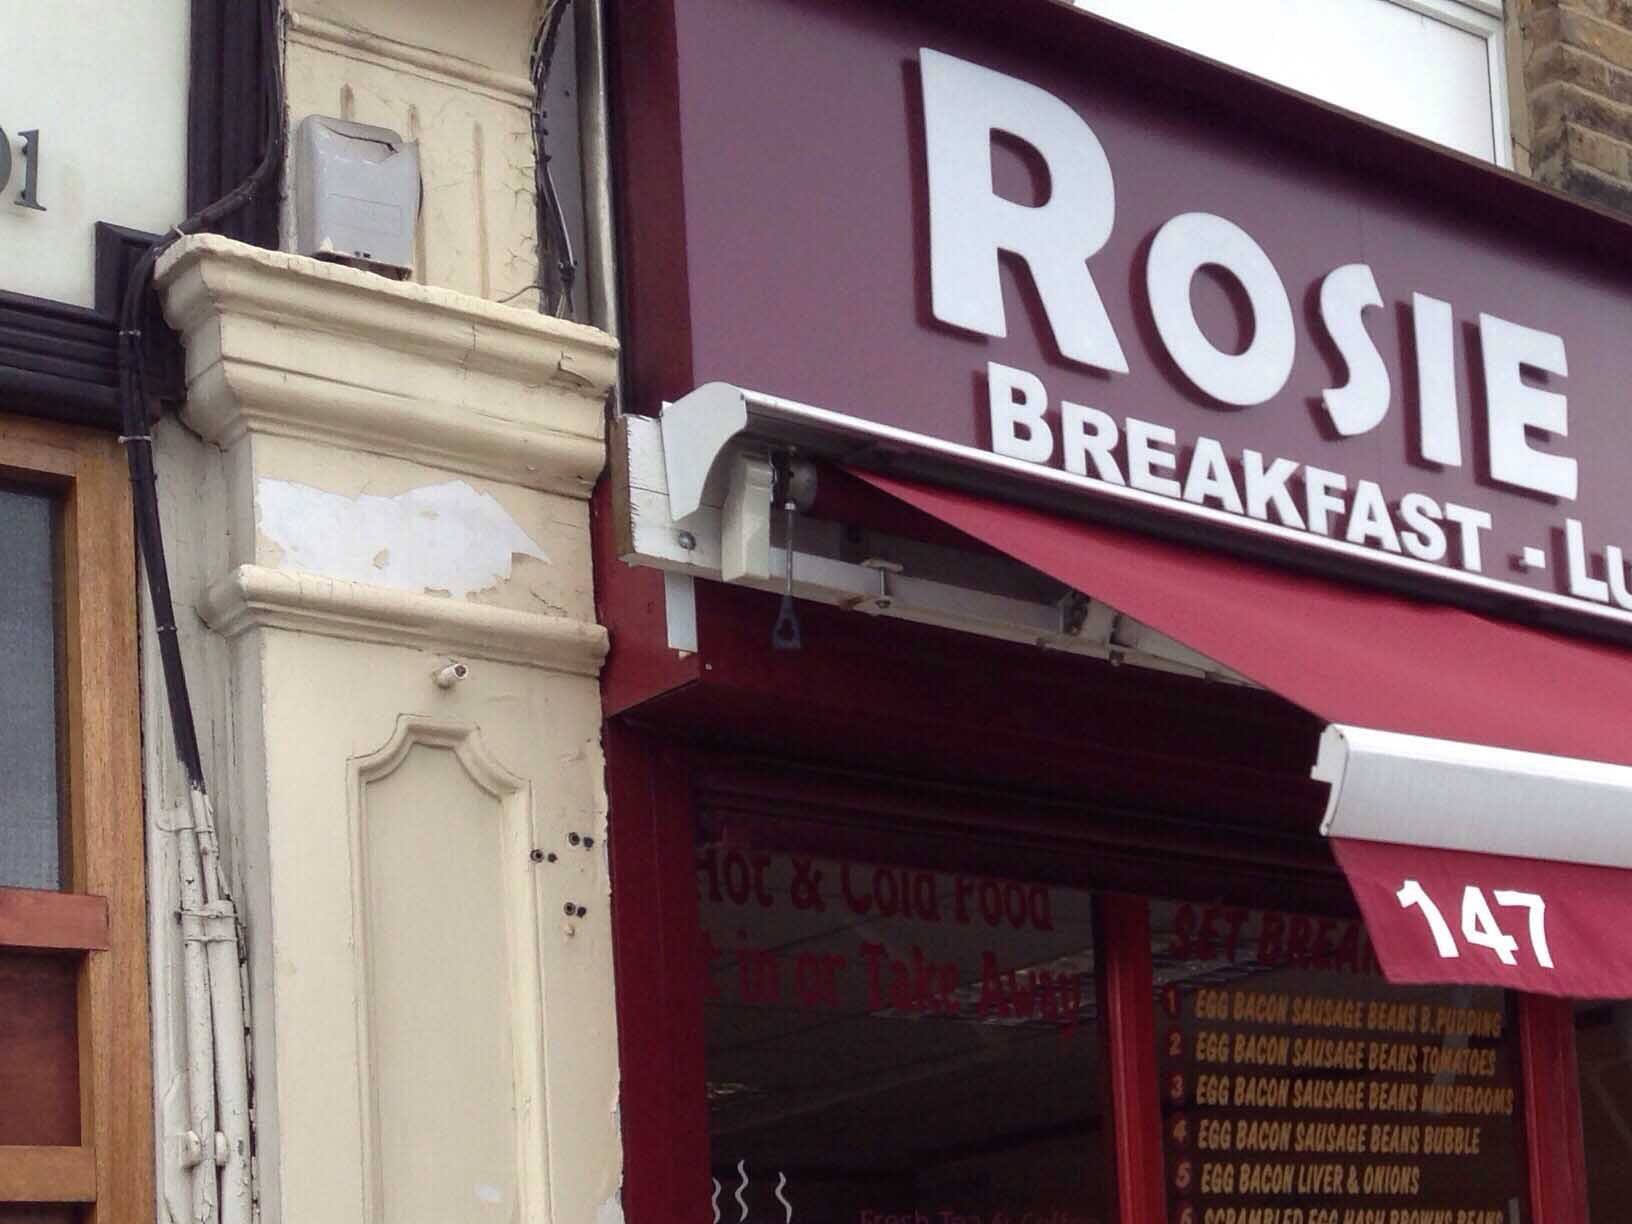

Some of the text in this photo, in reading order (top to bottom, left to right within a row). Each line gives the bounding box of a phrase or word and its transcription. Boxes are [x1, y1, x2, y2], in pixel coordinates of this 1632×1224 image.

[919, 47, 1578, 502] ROSIE
[987, 361, 1492, 572] BREAKFAST
[1396, 880, 1555, 969] 147
[1195, 990, 1228, 1021] EGG
[1233, 992, 1288, 1024] BACON
[1292, 996, 1363, 1028] SAUSAGE
[1195, 1032, 1229, 1062] EGG
[1233, 1035, 1288, 1066] BACON
[1292, 1039, 1365, 1069] SAUSAGE
[1368, 1041, 1417, 1072] BEANS
[1196, 1074, 1229, 1105] EGG
[1234, 1077, 1289, 1108] BACON
[1293, 1080, 1365, 1111] SAUSAGE
[1369, 1083, 1418, 1112] BEANS
[1198, 1120, 1231, 1150] EGG
[1236, 1120, 1292, 1151] BACON
[1294, 1122, 1367, 1153] SAUSAGE
[1370, 1124, 1420, 1154] BEANS
[1424, 1125, 1480, 1155] BUBBLE
[1201, 1163, 1234, 1194] EGG
[1239, 1164, 1295, 1194] BACON
[1298, 1165, 1344, 1194] LIVER
[1364, 1166, 1420, 1195] ONIONS
